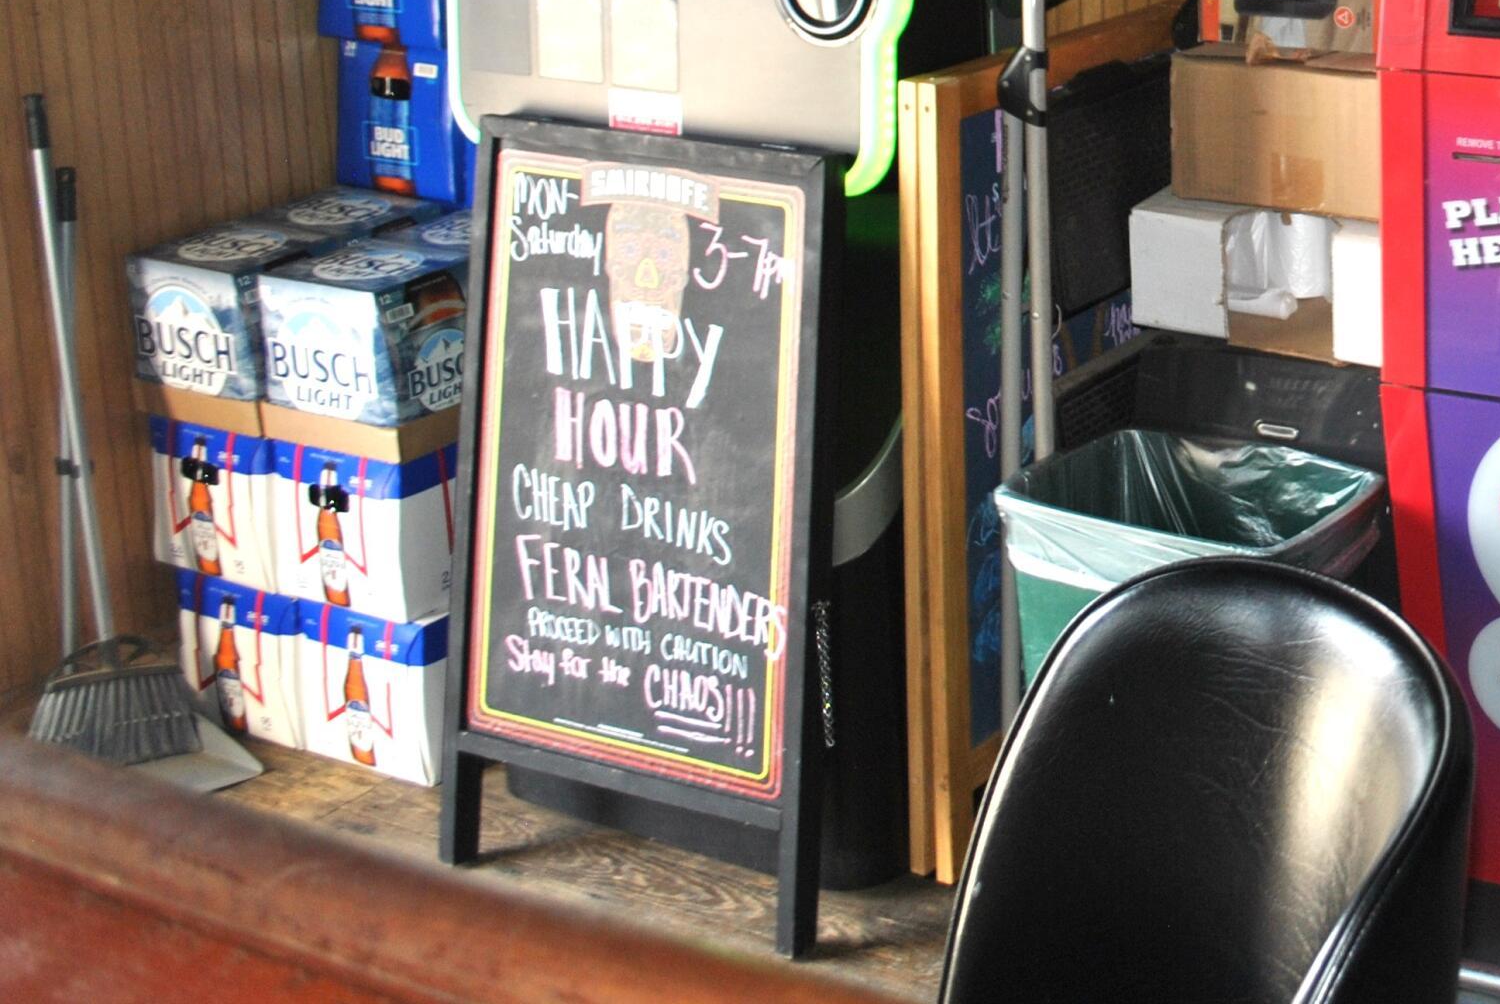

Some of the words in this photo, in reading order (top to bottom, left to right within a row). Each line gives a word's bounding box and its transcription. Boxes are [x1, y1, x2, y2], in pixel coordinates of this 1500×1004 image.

[370, 140, 410, 159] LIGHT
[374, 126, 404, 143] BUD
[1456, 137, 1494, 149] REMOVE
[510, 214, 603, 277] Saturday
[137, 316, 235, 374] BUSCH
[270, 341, 372, 394] BUSCH
[541, 286, 724, 409] HAPPY
[161, 360, 215, 387] LIGHT
[296, 385, 352, 410] LIGHT
[411, 353, 464, 397] BUSC
[429, 387, 462, 405] LIGH
[554, 386, 697, 485] HOUR
[512, 463, 595, 531] CHEAP
[621, 483, 732, 566] DRINKS
[516, 534, 622, 614] FERAL
[629, 558, 787, 661] BARTENDERS
[505, 634, 555, 688] Stay
[559, 648, 593, 679] for
[597, 656, 631, 687] the
[528, 606, 601, 646] PROCEED
[605, 624, 650, 655] WITH
[660, 633, 748, 680] CAUTION
